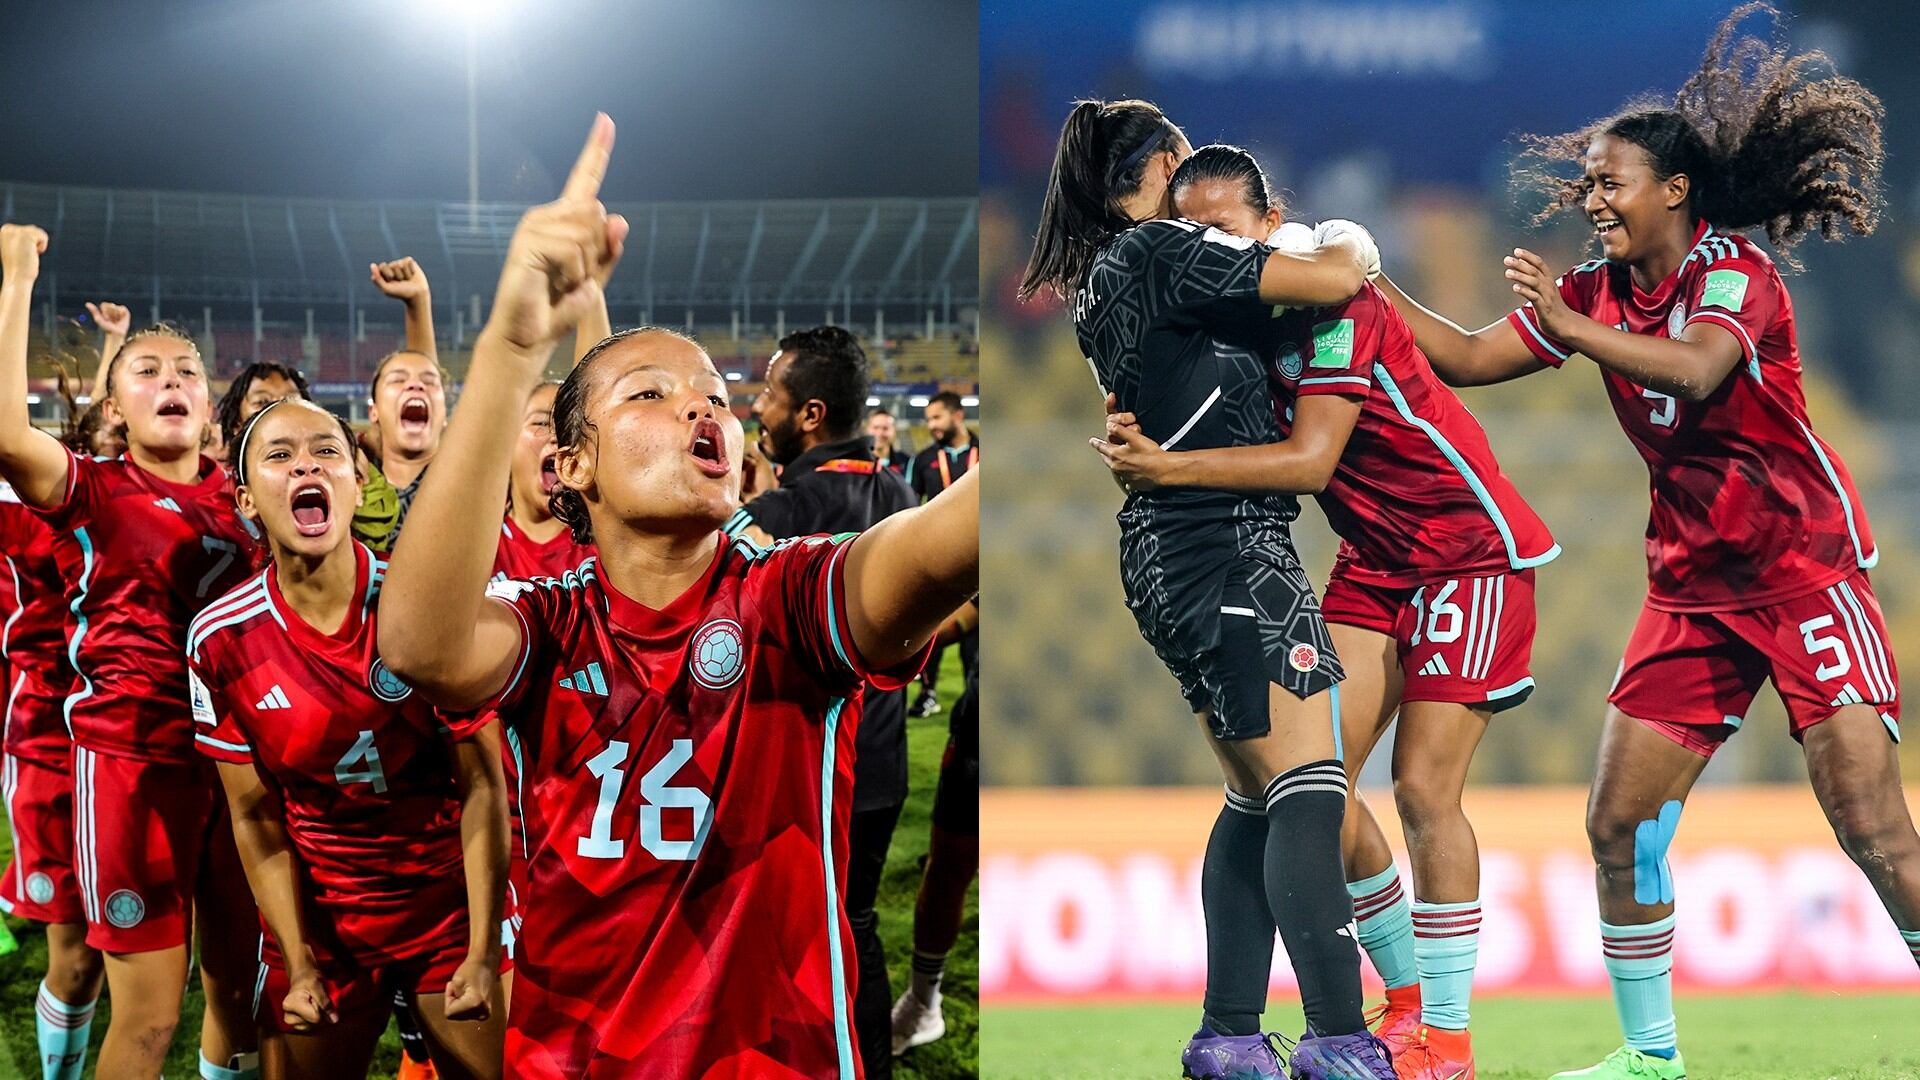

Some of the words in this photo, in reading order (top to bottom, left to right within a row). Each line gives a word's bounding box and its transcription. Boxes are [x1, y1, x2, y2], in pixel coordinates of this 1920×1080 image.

[1331, 347, 1349, 355] FIFA
[196, 535, 237, 598] 7
[1410, 579, 1464, 647] 16
[1798, 613, 1852, 682] 5
[333, 729, 388, 794] 4
[577, 738, 714, 861] 16
